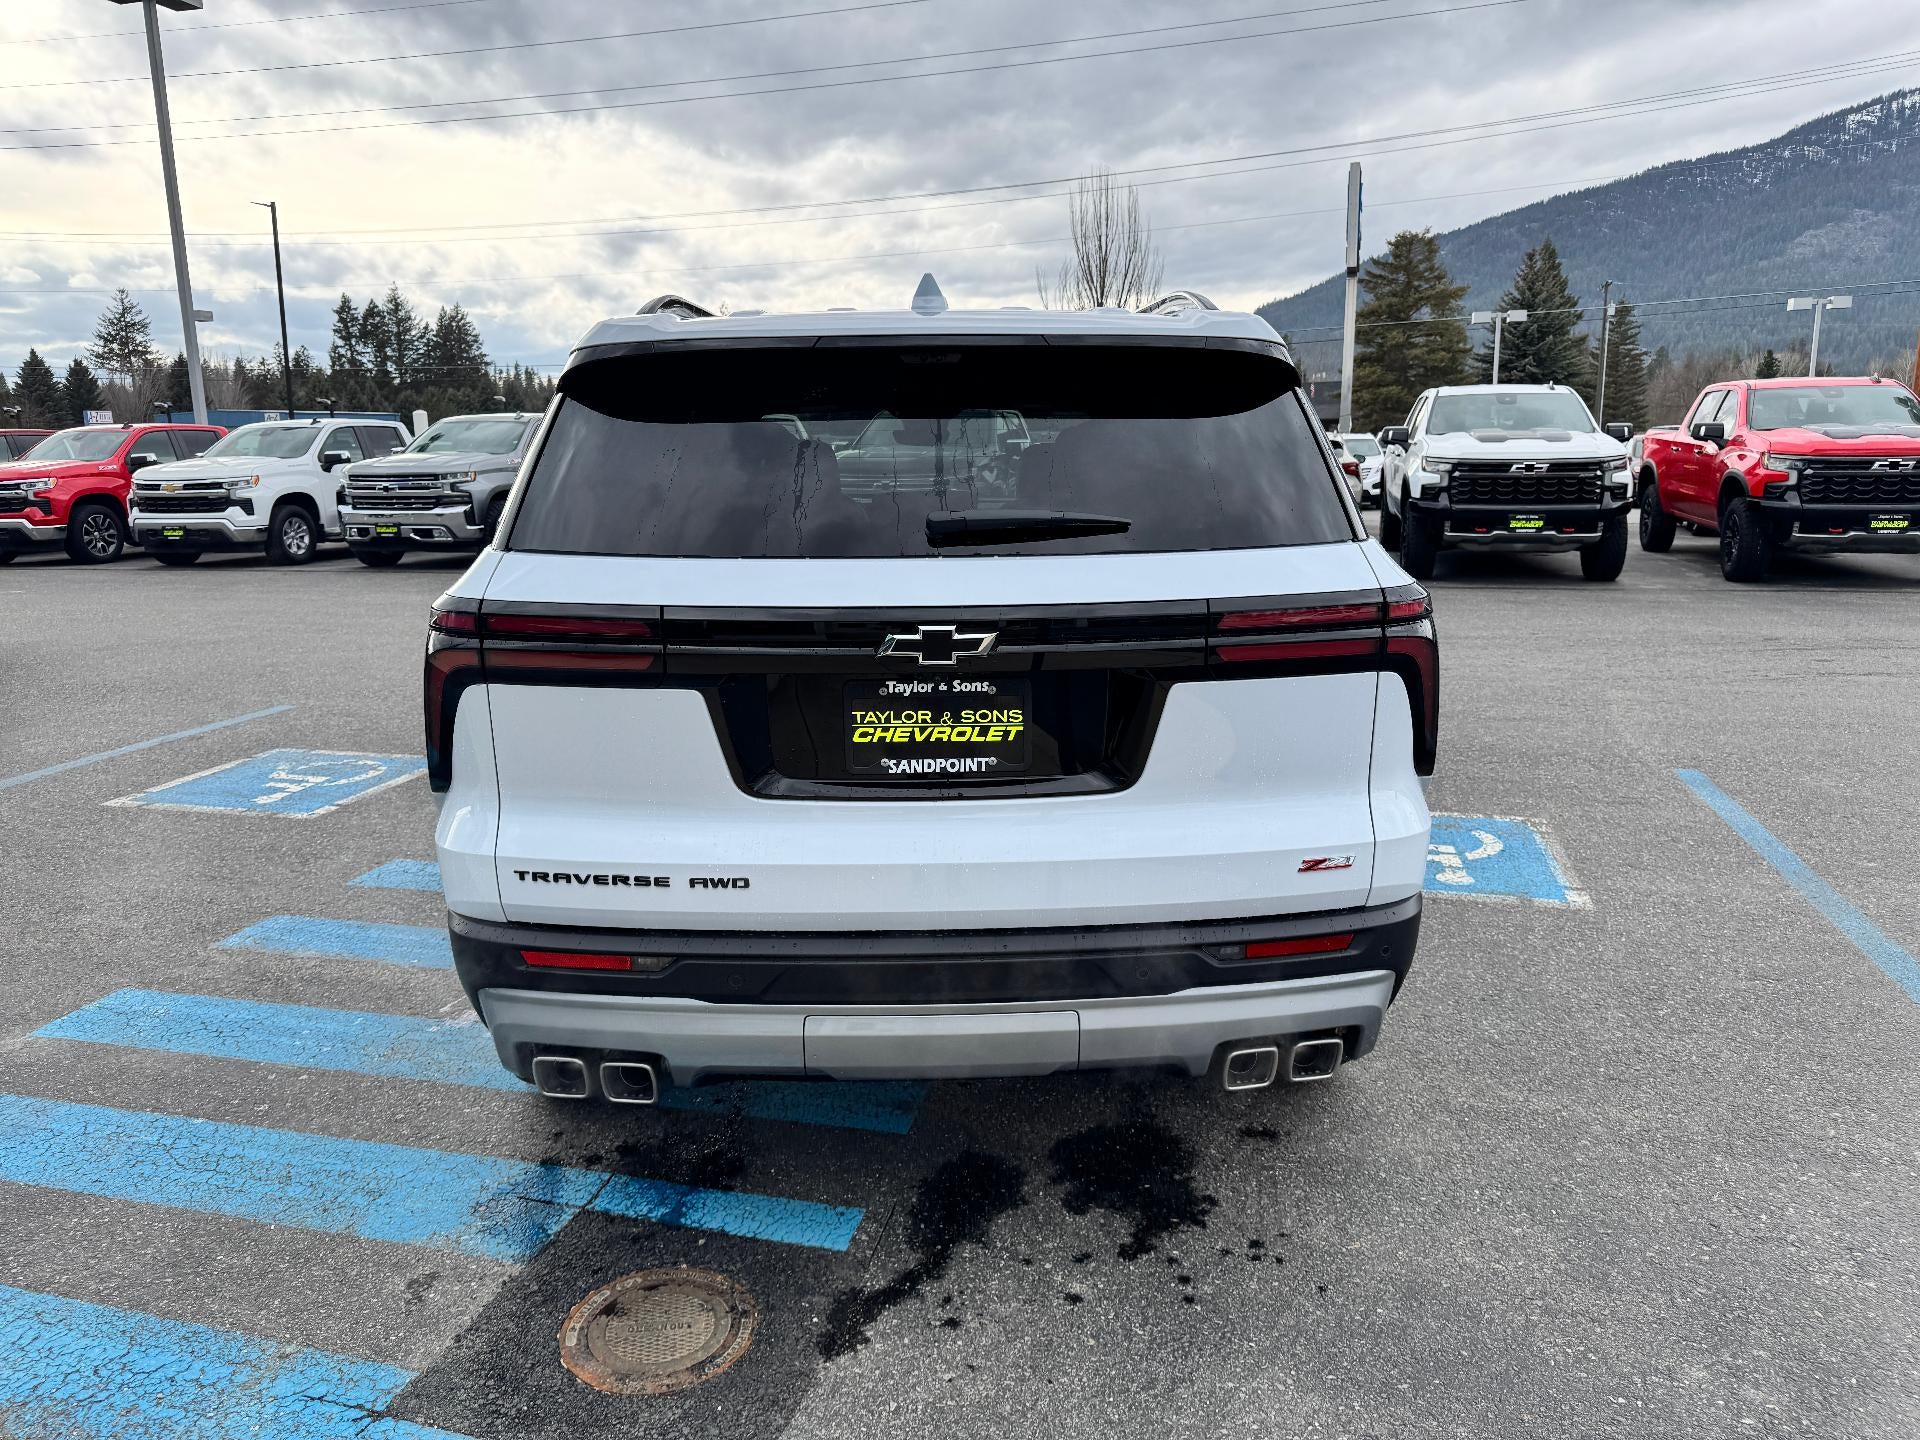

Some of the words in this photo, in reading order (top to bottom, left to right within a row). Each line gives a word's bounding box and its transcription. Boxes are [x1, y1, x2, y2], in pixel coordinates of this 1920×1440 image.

[886, 680, 934, 696] Taylor
[939, 682, 948, 691] &
[952, 680, 990, 693] Sons
[852, 710, 932, 724] TAYLOR
[940, 711, 953, 726] &
[961, 709, 1024, 723] SONS
[852, 726, 1024, 743] CHEVROLET
[888, 757, 989, 774] SANDPOINT
[513, 869, 671, 888] TRAVERSE
[688, 877, 751, 889] AWD
